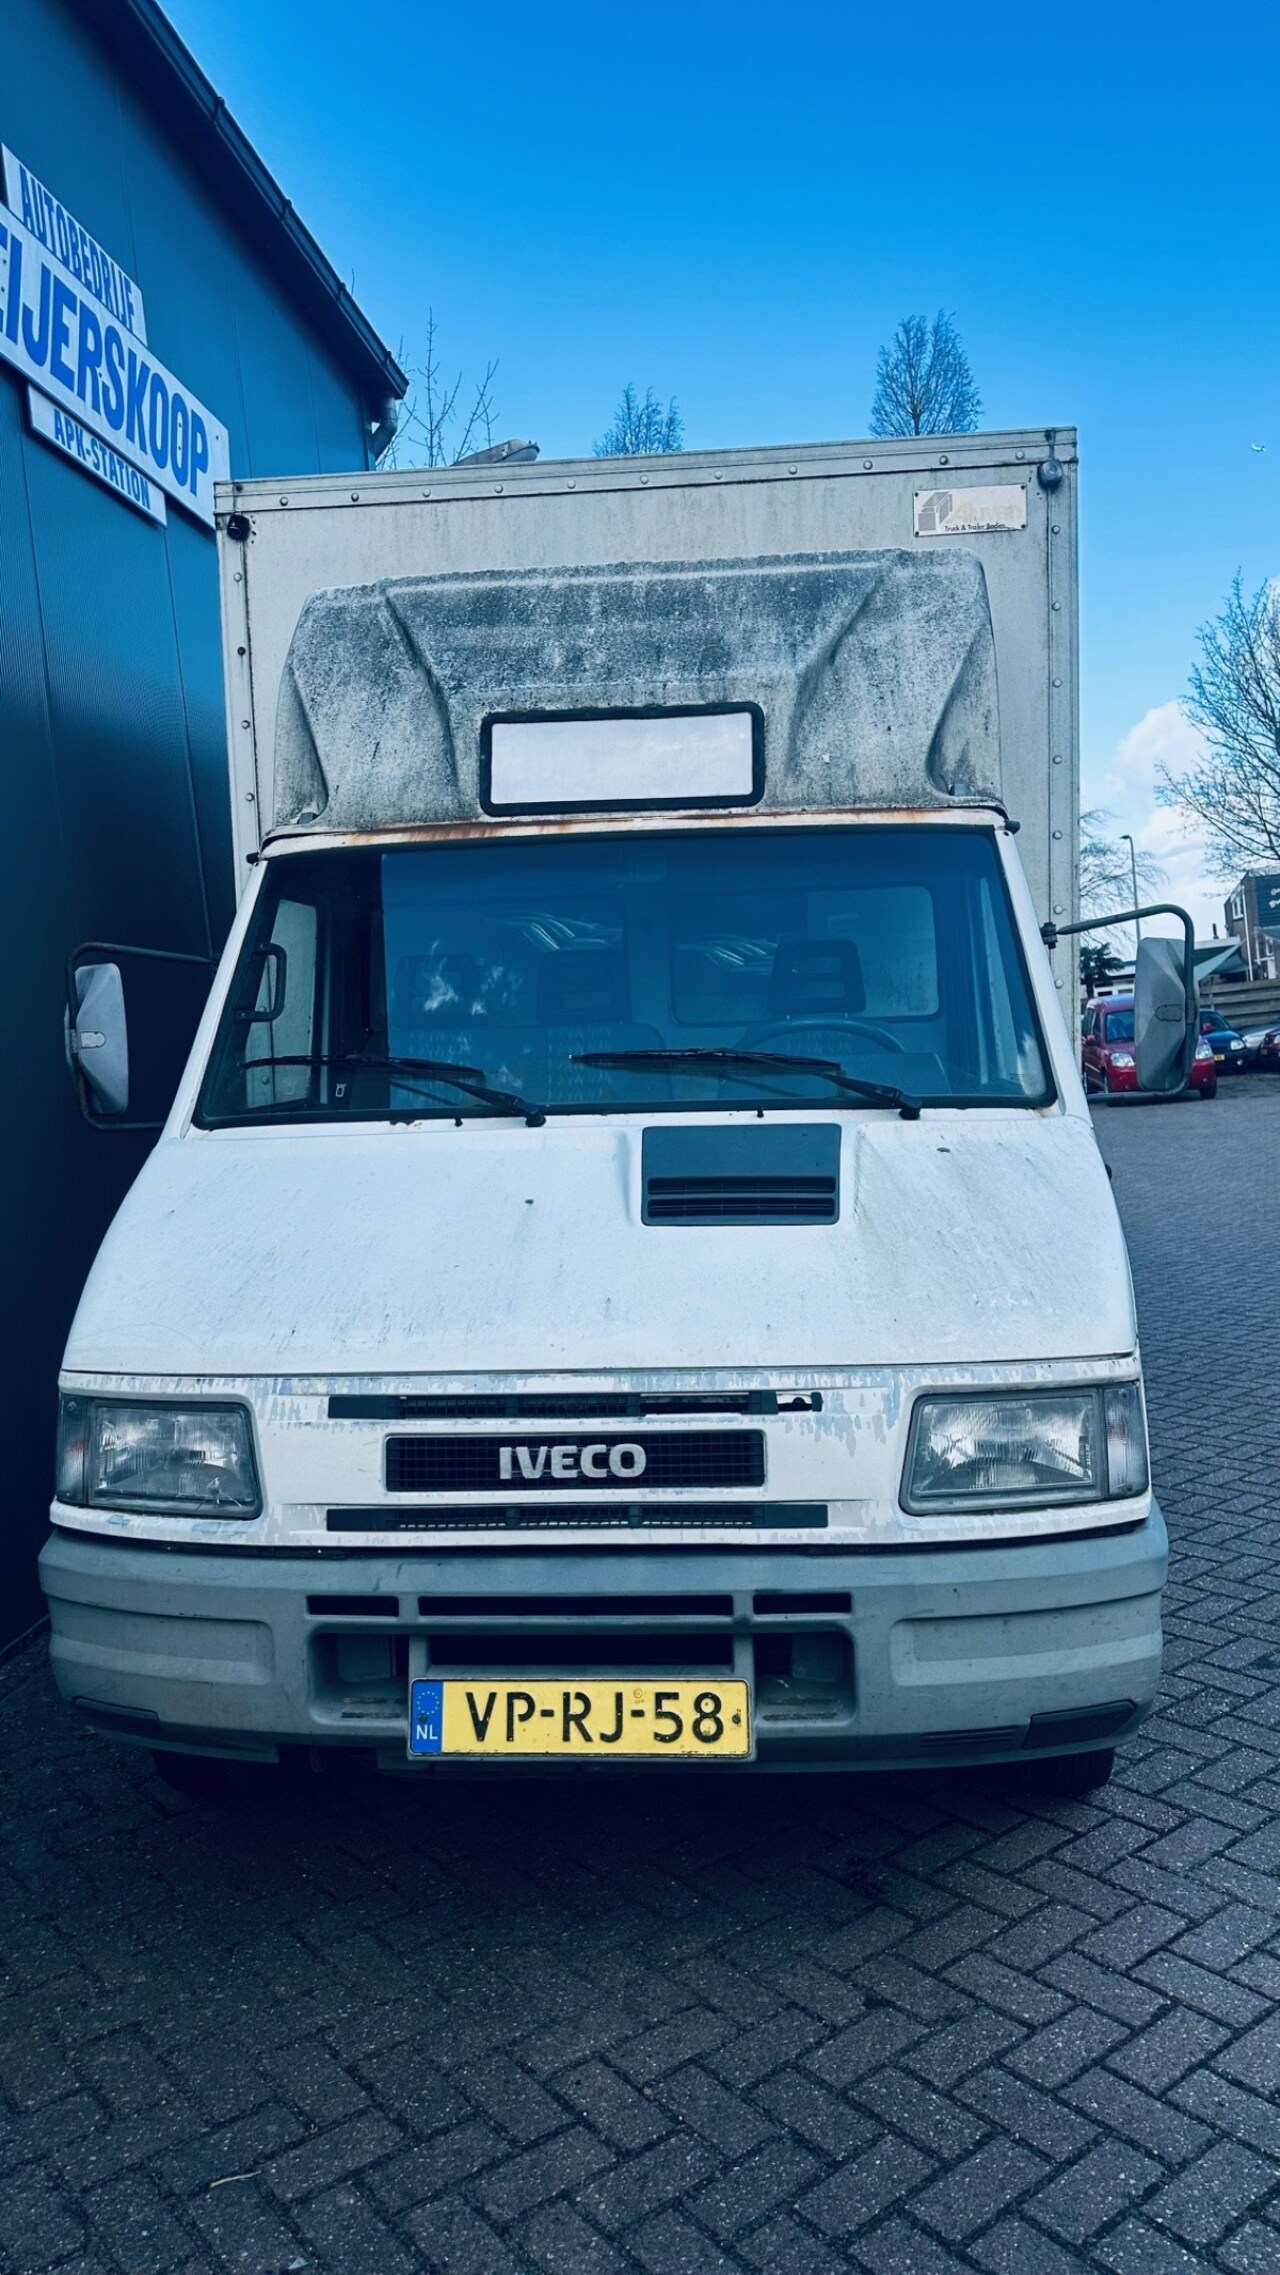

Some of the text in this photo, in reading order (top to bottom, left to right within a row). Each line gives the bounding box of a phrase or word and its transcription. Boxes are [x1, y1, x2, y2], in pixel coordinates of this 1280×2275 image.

[19, 163, 134, 334] AUTOBEDRIJF
[54, 408, 151, 511] APK-STATION
[499, 1443, 647, 1479] IVECO
[416, 1724, 438, 1740] NL
[465, 1691, 724, 1743] VP-RJ-58
